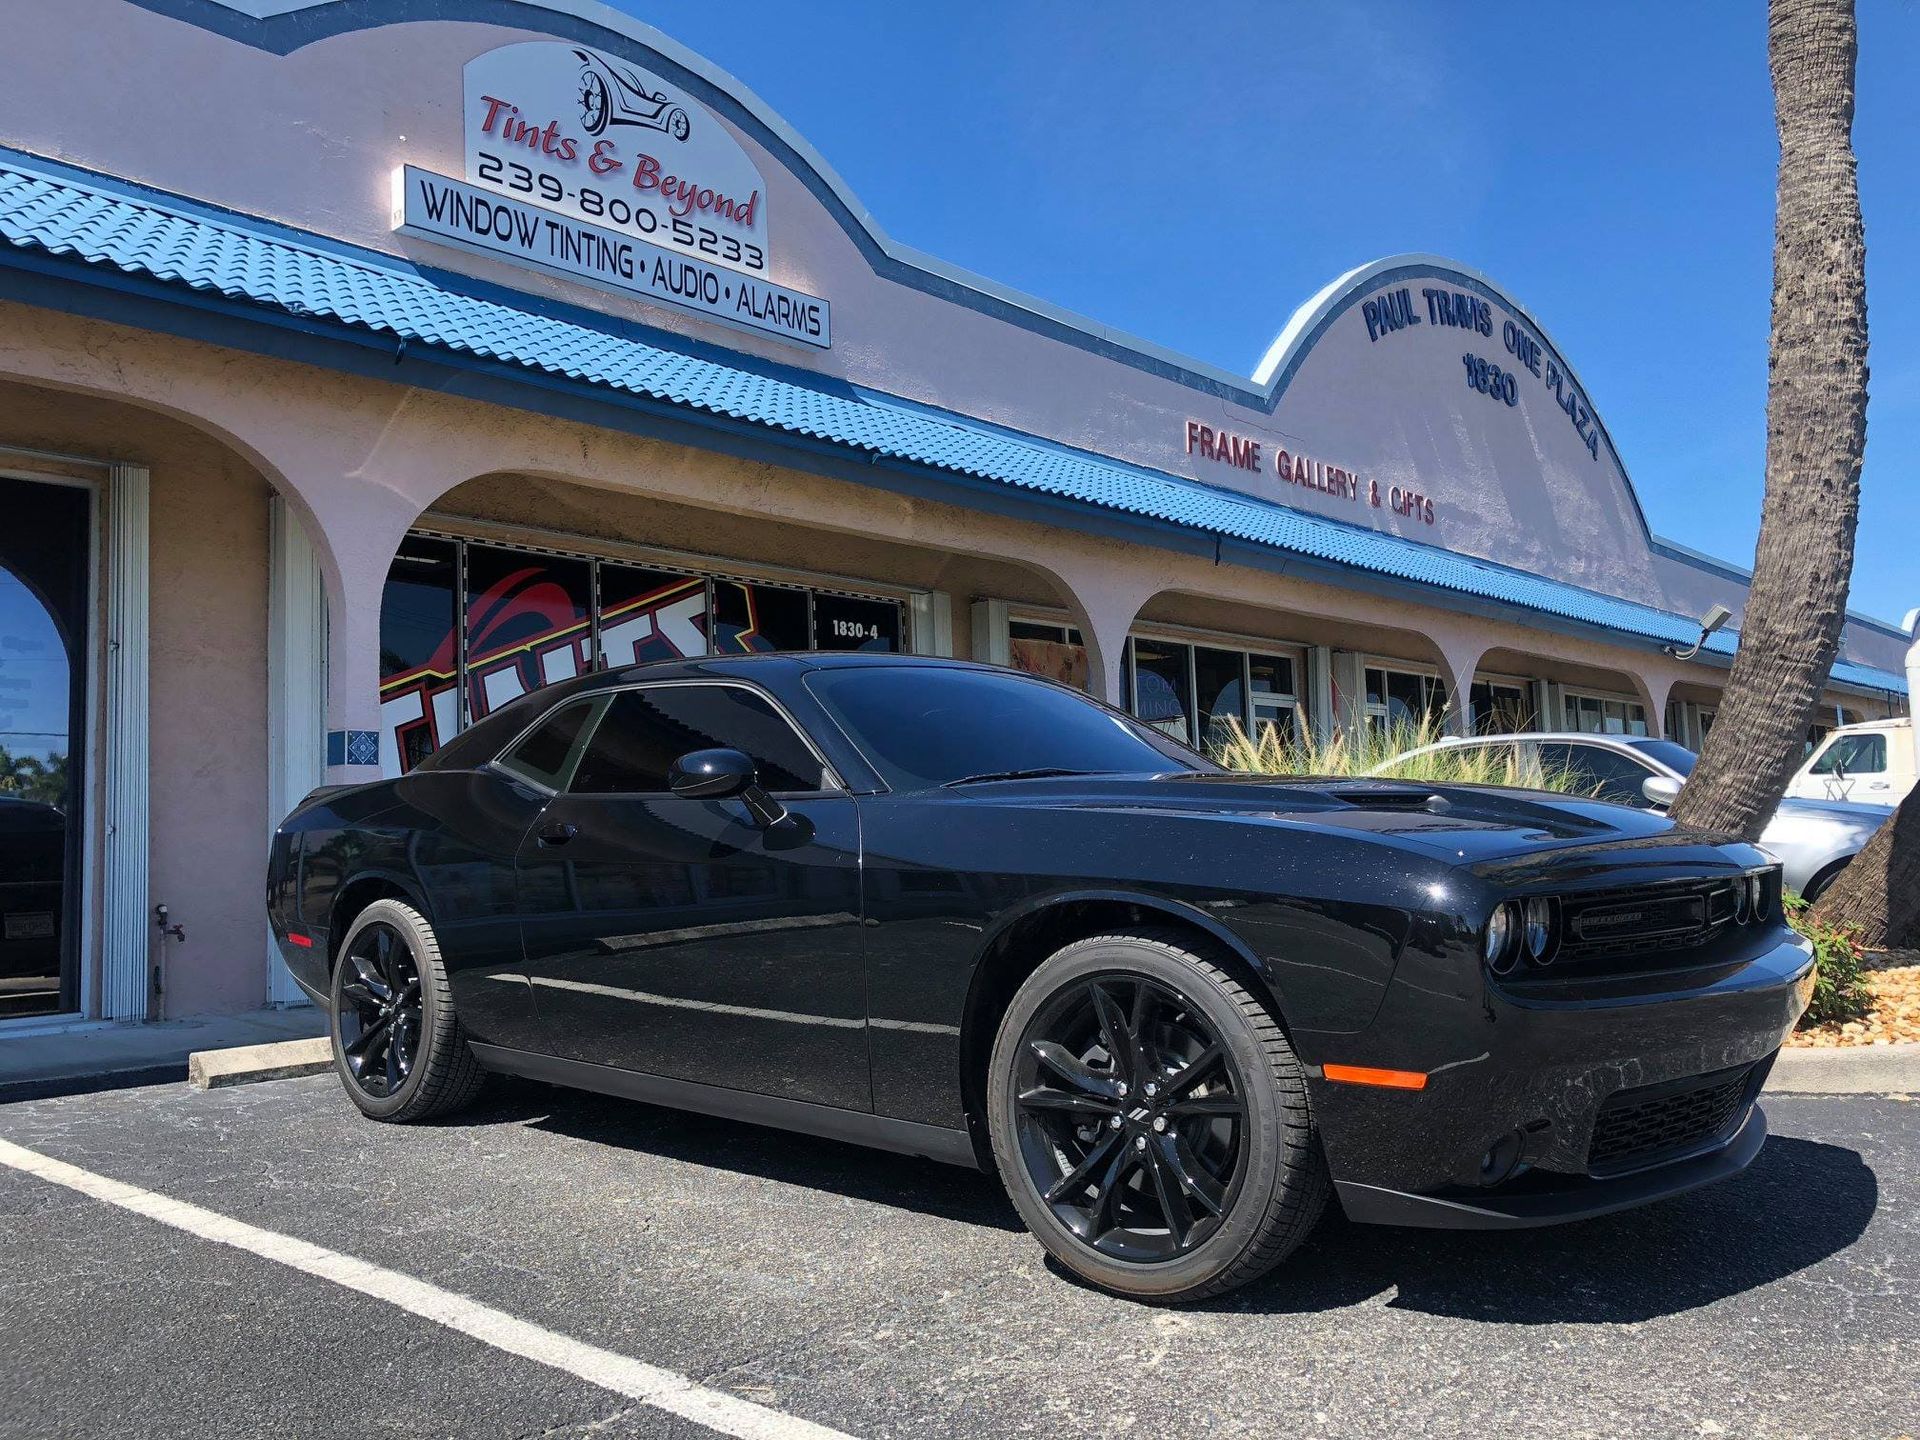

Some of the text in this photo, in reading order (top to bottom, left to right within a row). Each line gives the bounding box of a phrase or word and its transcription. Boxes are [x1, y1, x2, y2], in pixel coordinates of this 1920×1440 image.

[479, 152, 763, 269] 239-800-5233
[481, 96, 757, 225] Tints & Beyond
[420, 180, 820, 336] WINDOW TINTING AUDIO ALARMS
[1362, 288, 1598, 462] PAUL TRAVIS ONE PLAZA
[1463, 353, 1518, 407] 1830
[1186, 421, 1434, 526] FRAME GALLERY & GIFTS
[833, 620, 878, 640] 1830-4
